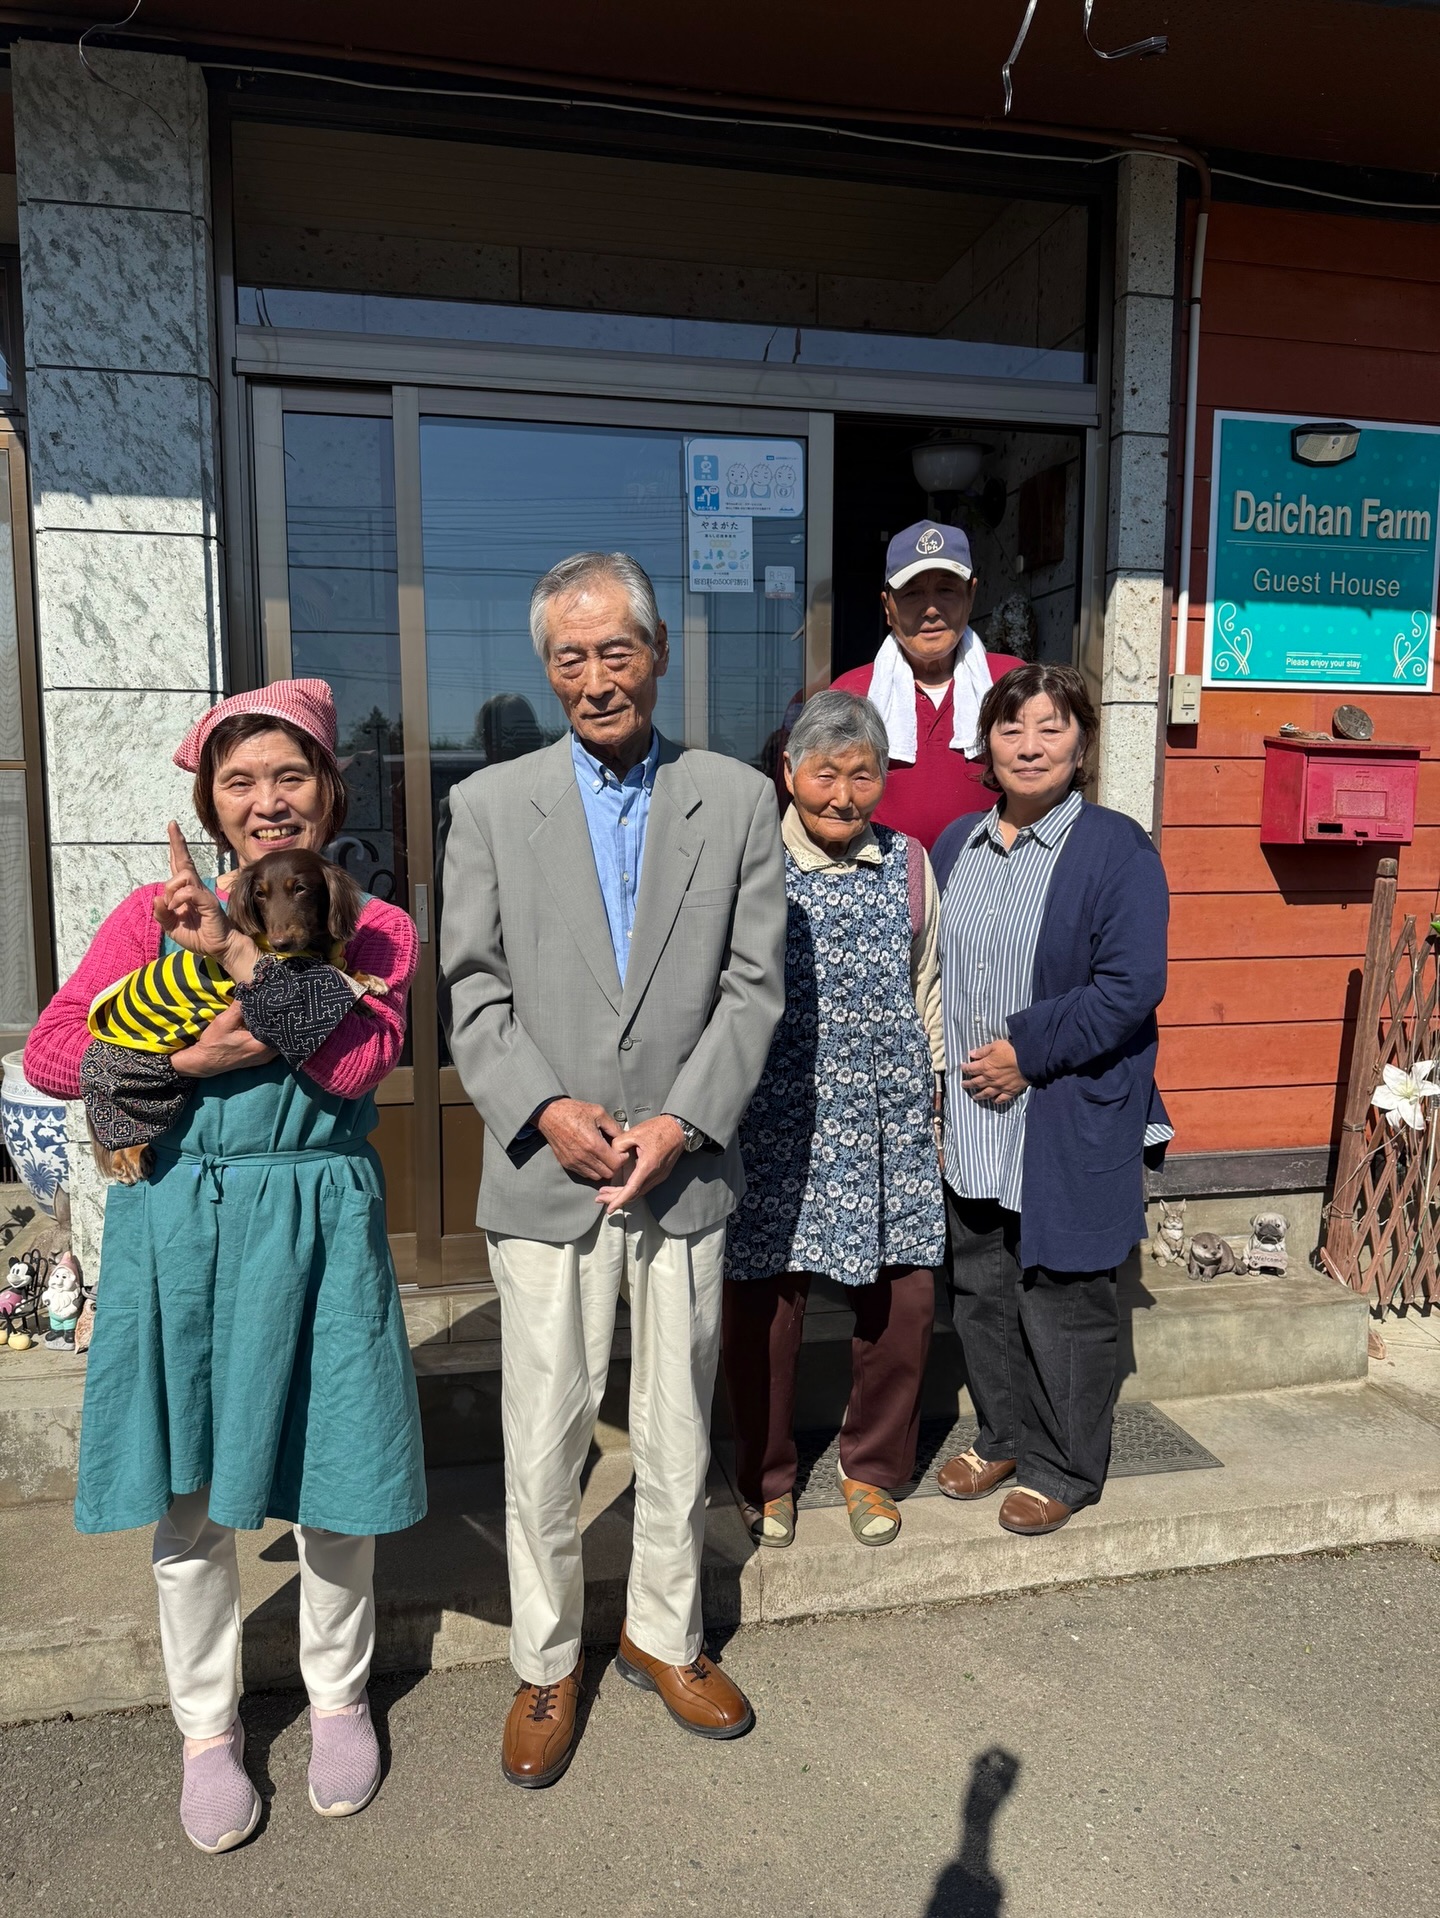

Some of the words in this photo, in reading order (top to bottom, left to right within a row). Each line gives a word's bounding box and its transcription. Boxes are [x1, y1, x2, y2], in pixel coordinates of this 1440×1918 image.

[701, 521, 739, 530] やまがた
[1233, 490, 1352, 536] Daichan
[1361, 498, 1431, 541] Farm
[1253, 568, 1321, 594] Guest
[1330, 571, 1401, 597] House
[1286, 657, 1309, 666] Please
[1310, 659, 1329, 668] enjoy
[1330, 660, 1345, 668] your
[1346, 660, 1362, 669] stay.
